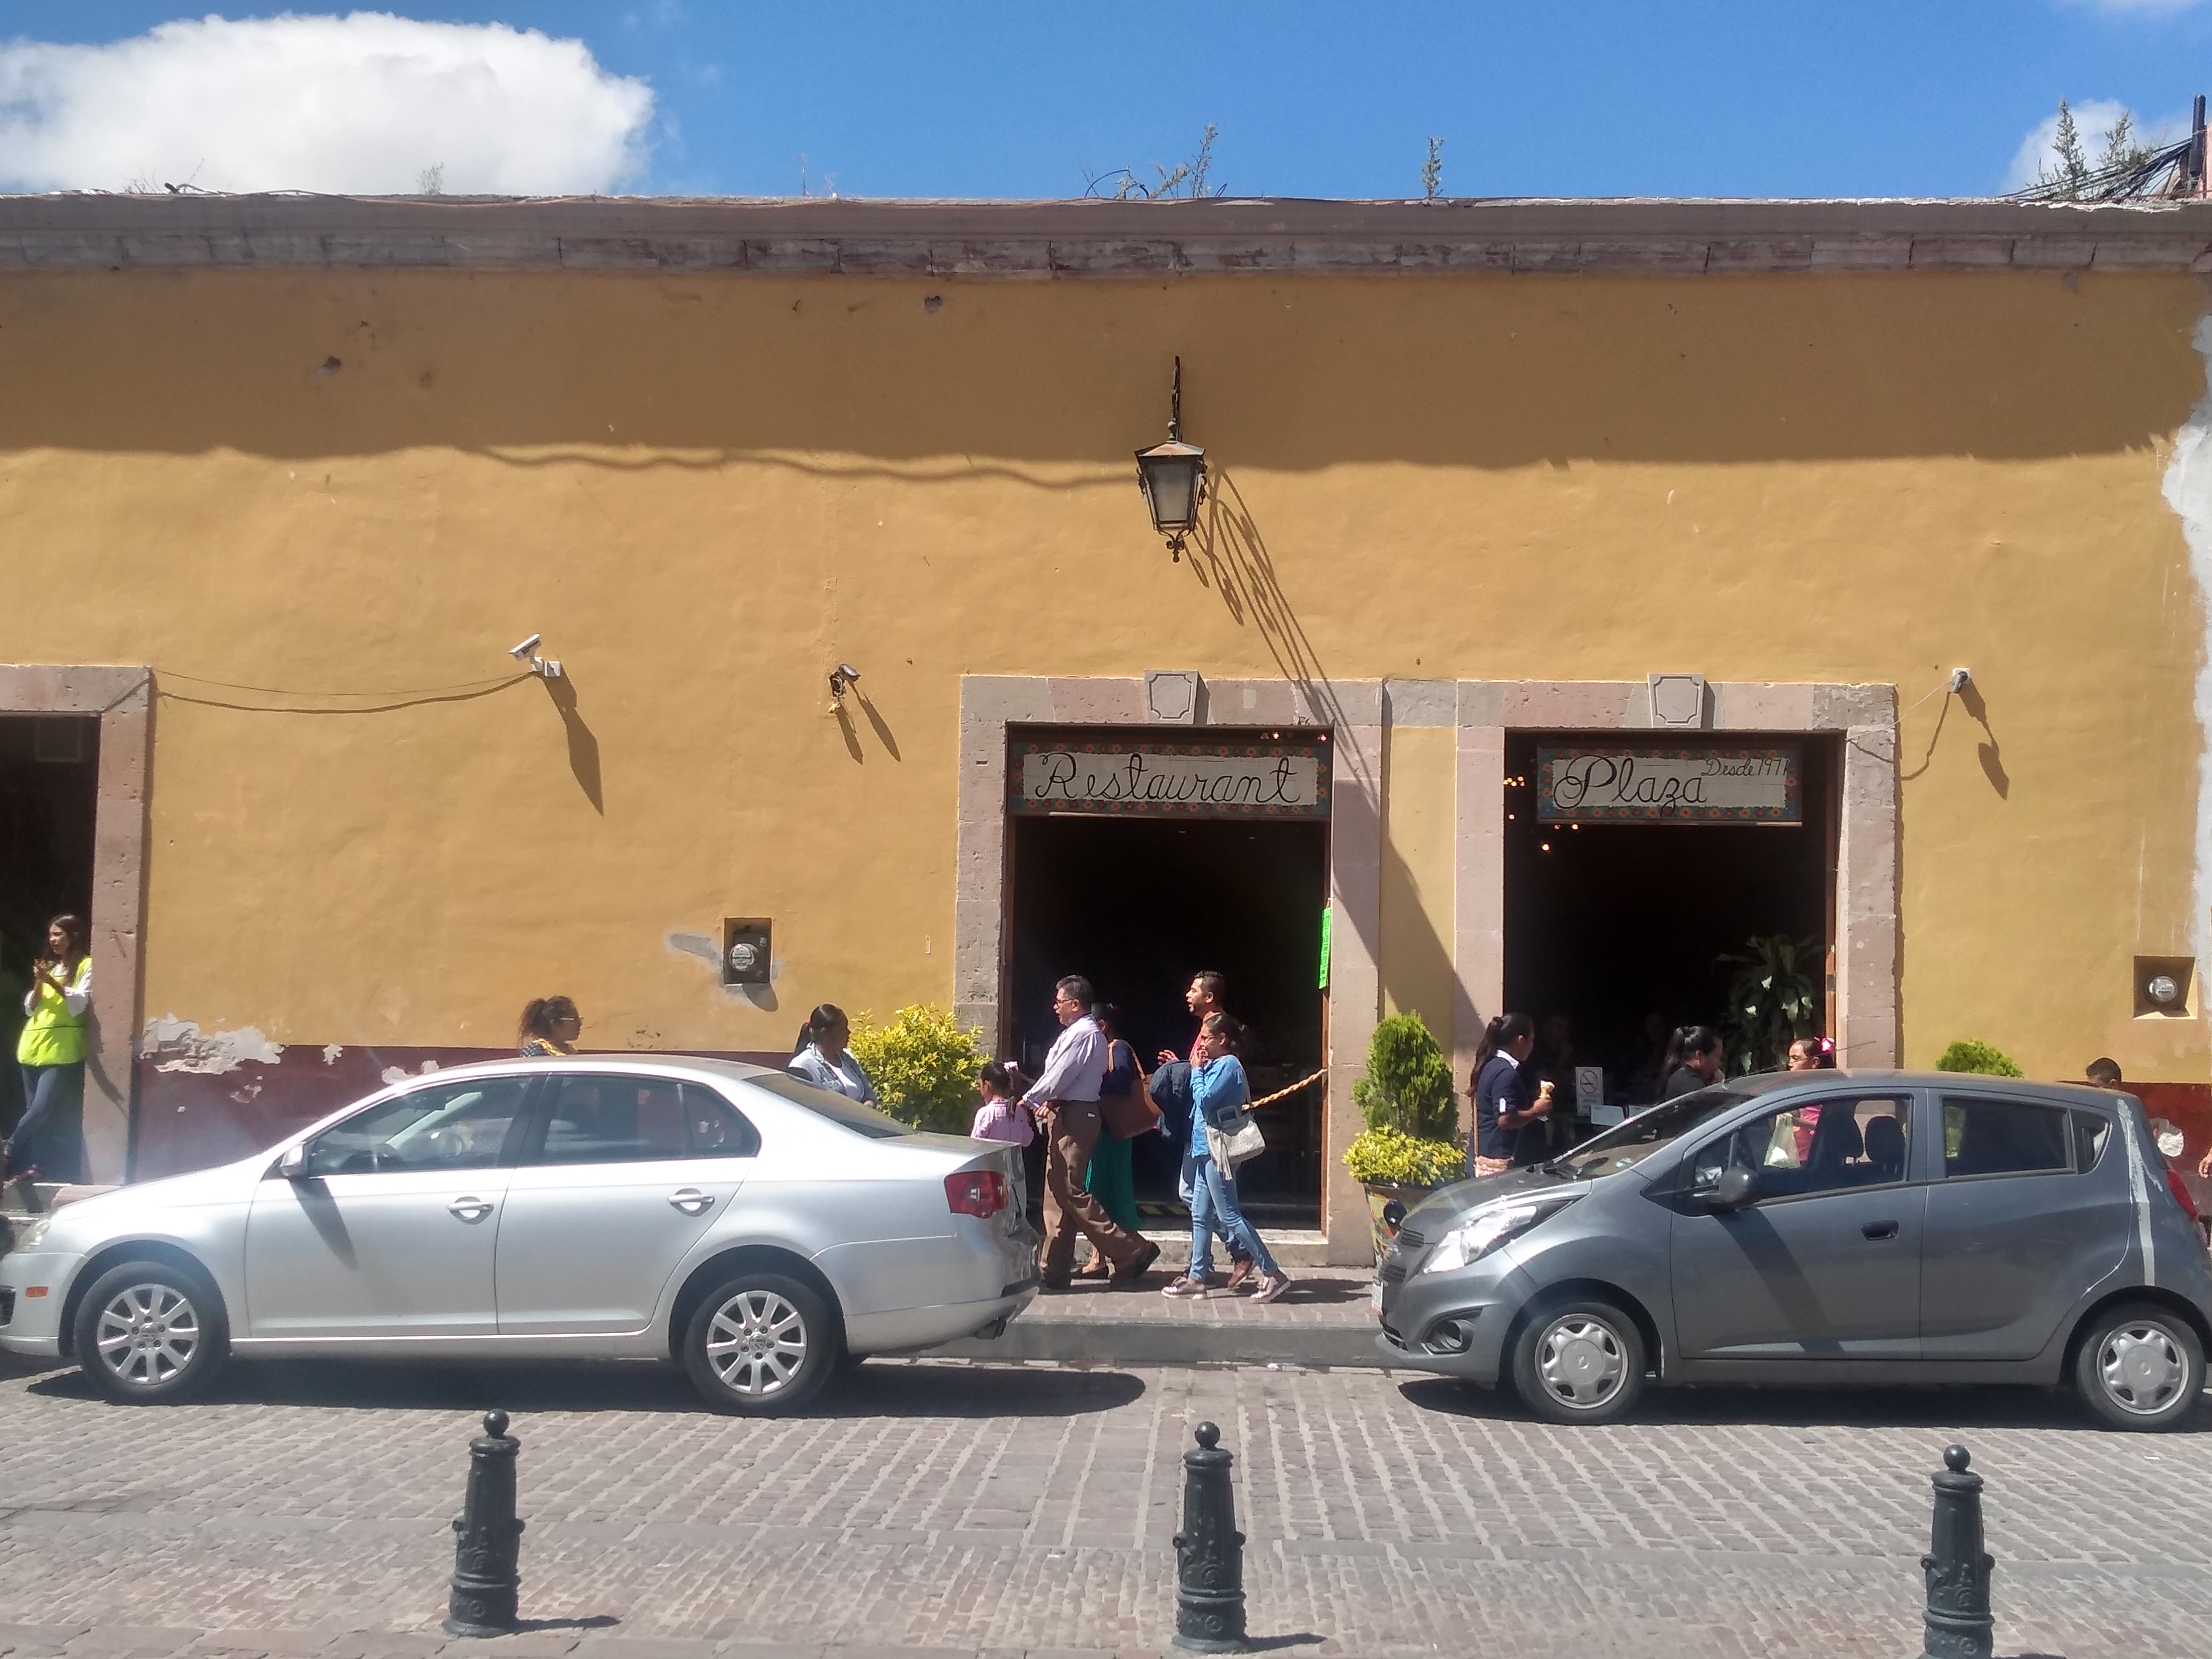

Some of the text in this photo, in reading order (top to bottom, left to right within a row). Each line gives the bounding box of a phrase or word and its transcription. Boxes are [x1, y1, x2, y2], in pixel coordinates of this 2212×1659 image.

[1035, 752, 1301, 803] Restaurant
[1553, 754, 1708, 818] Plaza
[1700, 757, 1789, 776] Desde 1971
